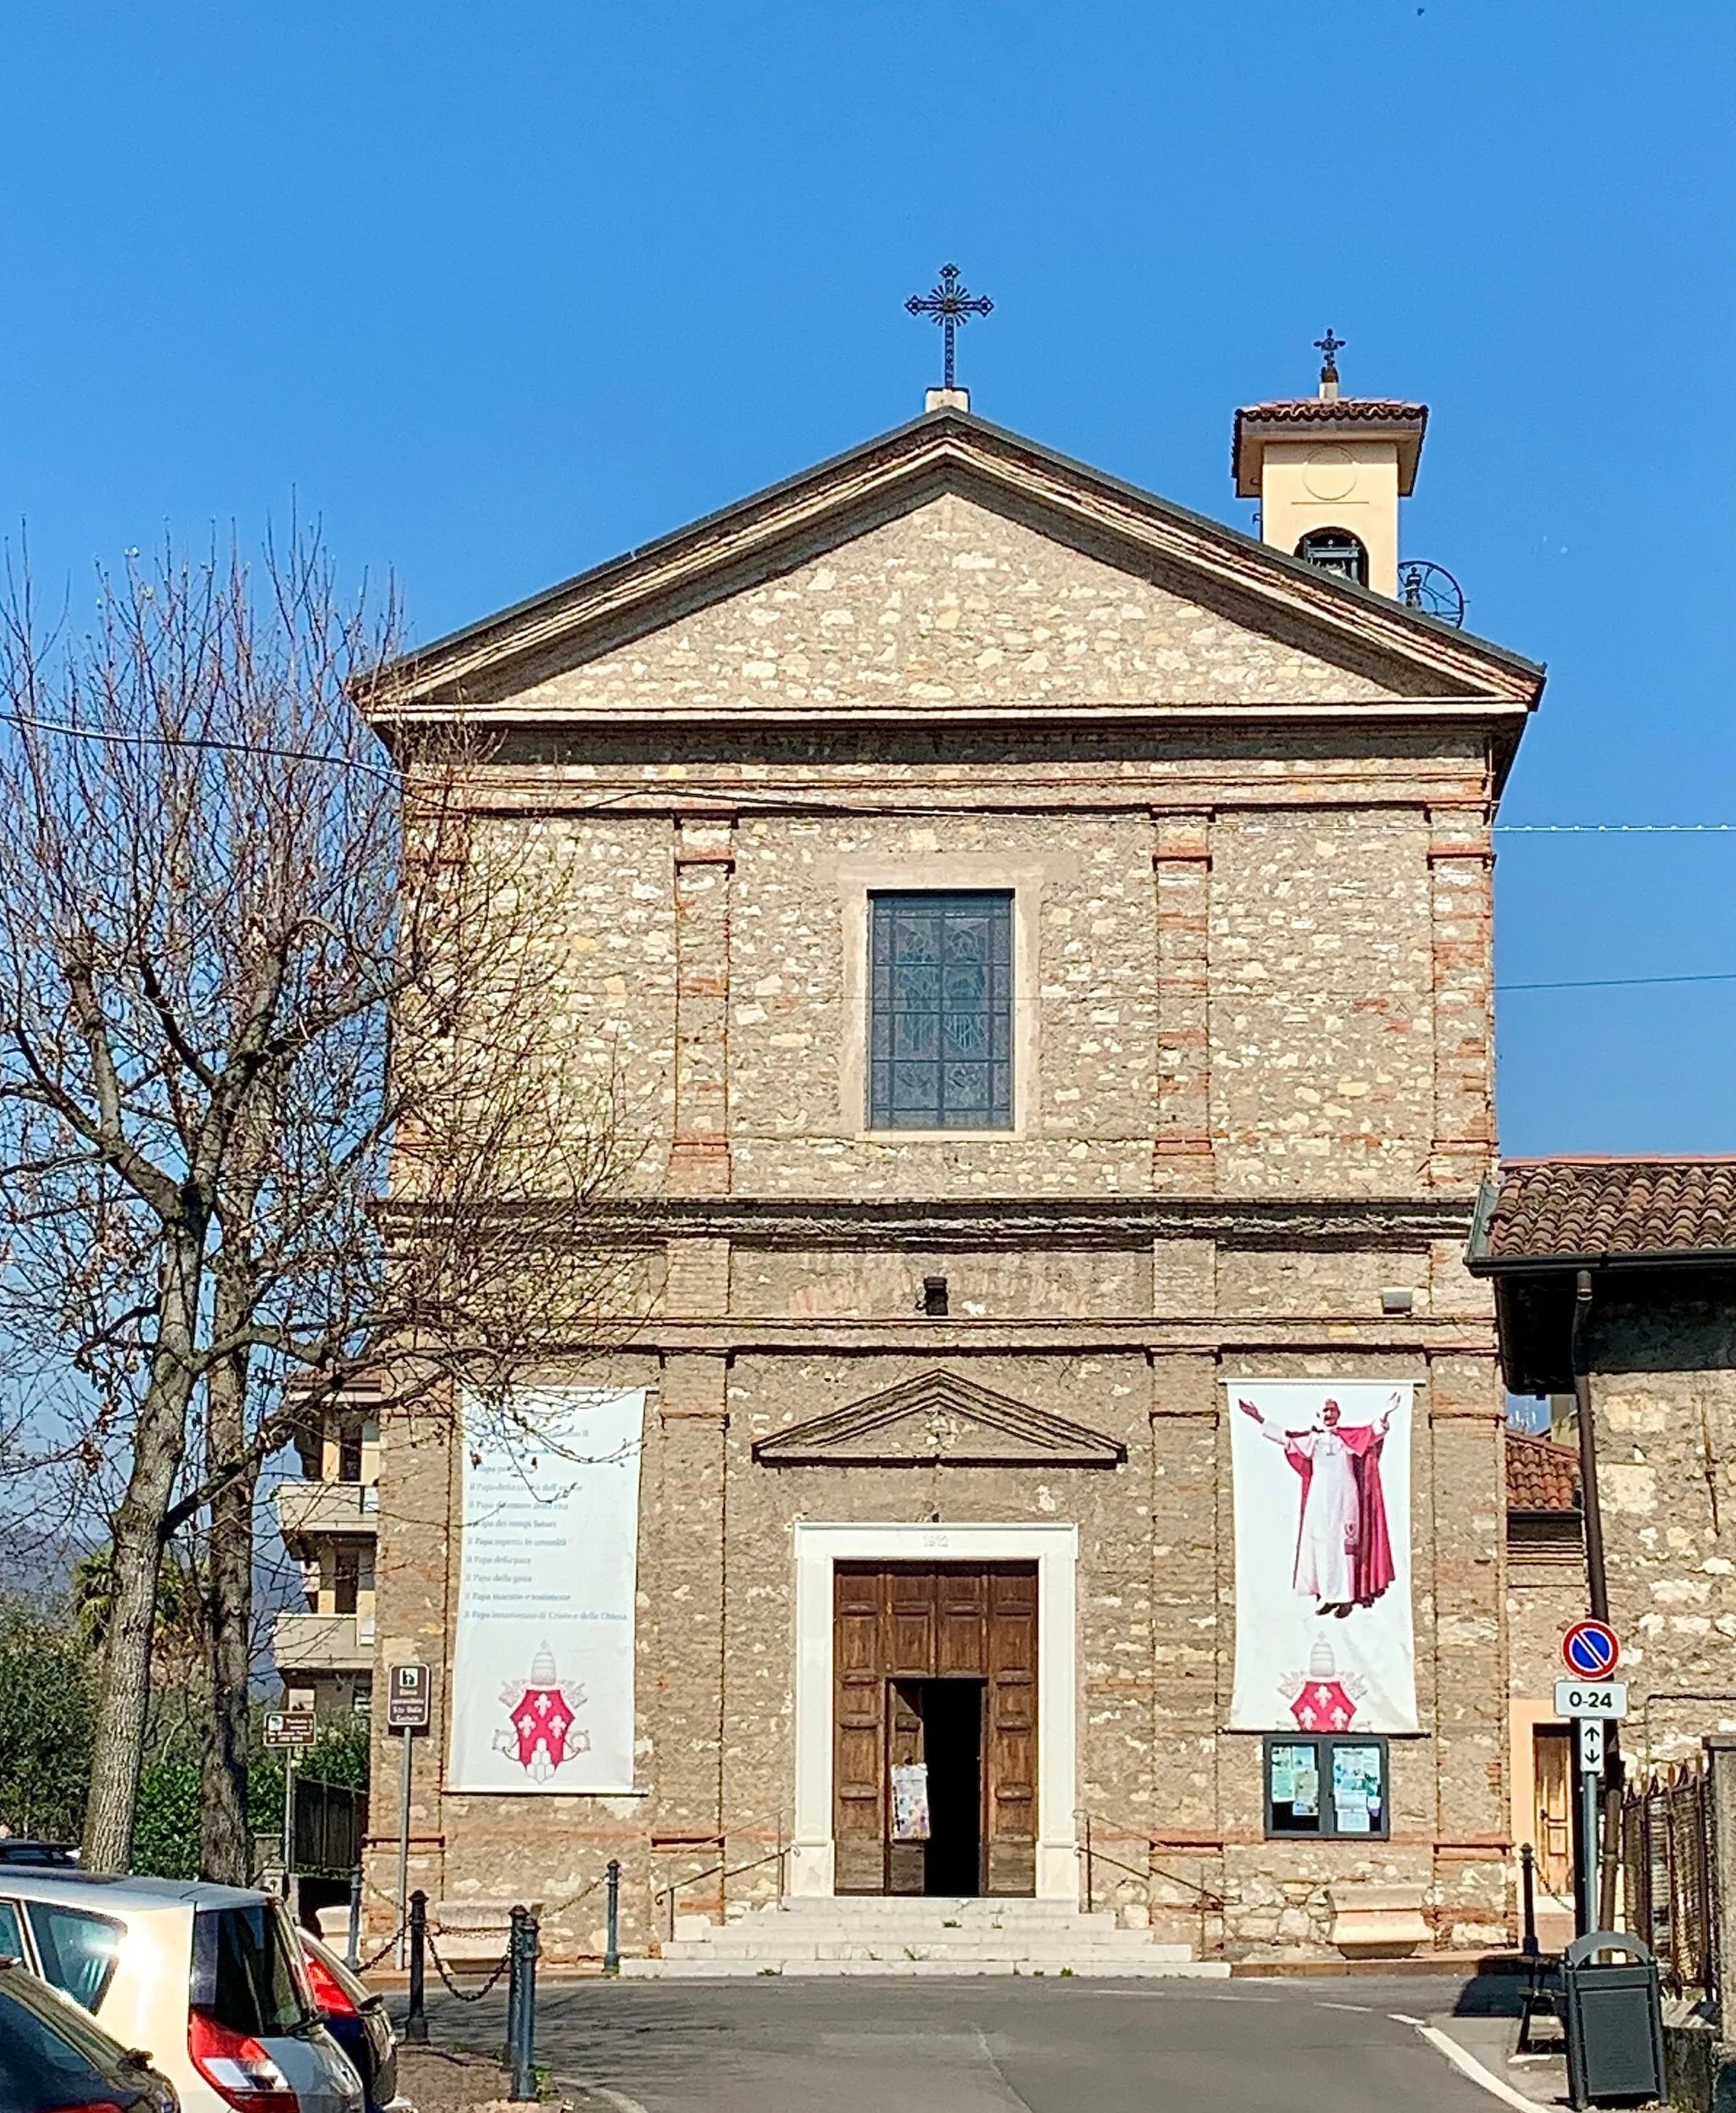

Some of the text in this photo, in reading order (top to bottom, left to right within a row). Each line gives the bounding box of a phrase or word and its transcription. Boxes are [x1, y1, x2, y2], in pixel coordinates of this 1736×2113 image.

[474, 1555, 493, 1565] Papa
[472, 1574, 492, 1583] Papa
[472, 1592, 492, 1602] Papa
[471, 1610, 491, 1621] Papa
[1569, 1691, 1613, 1708] 0-24
